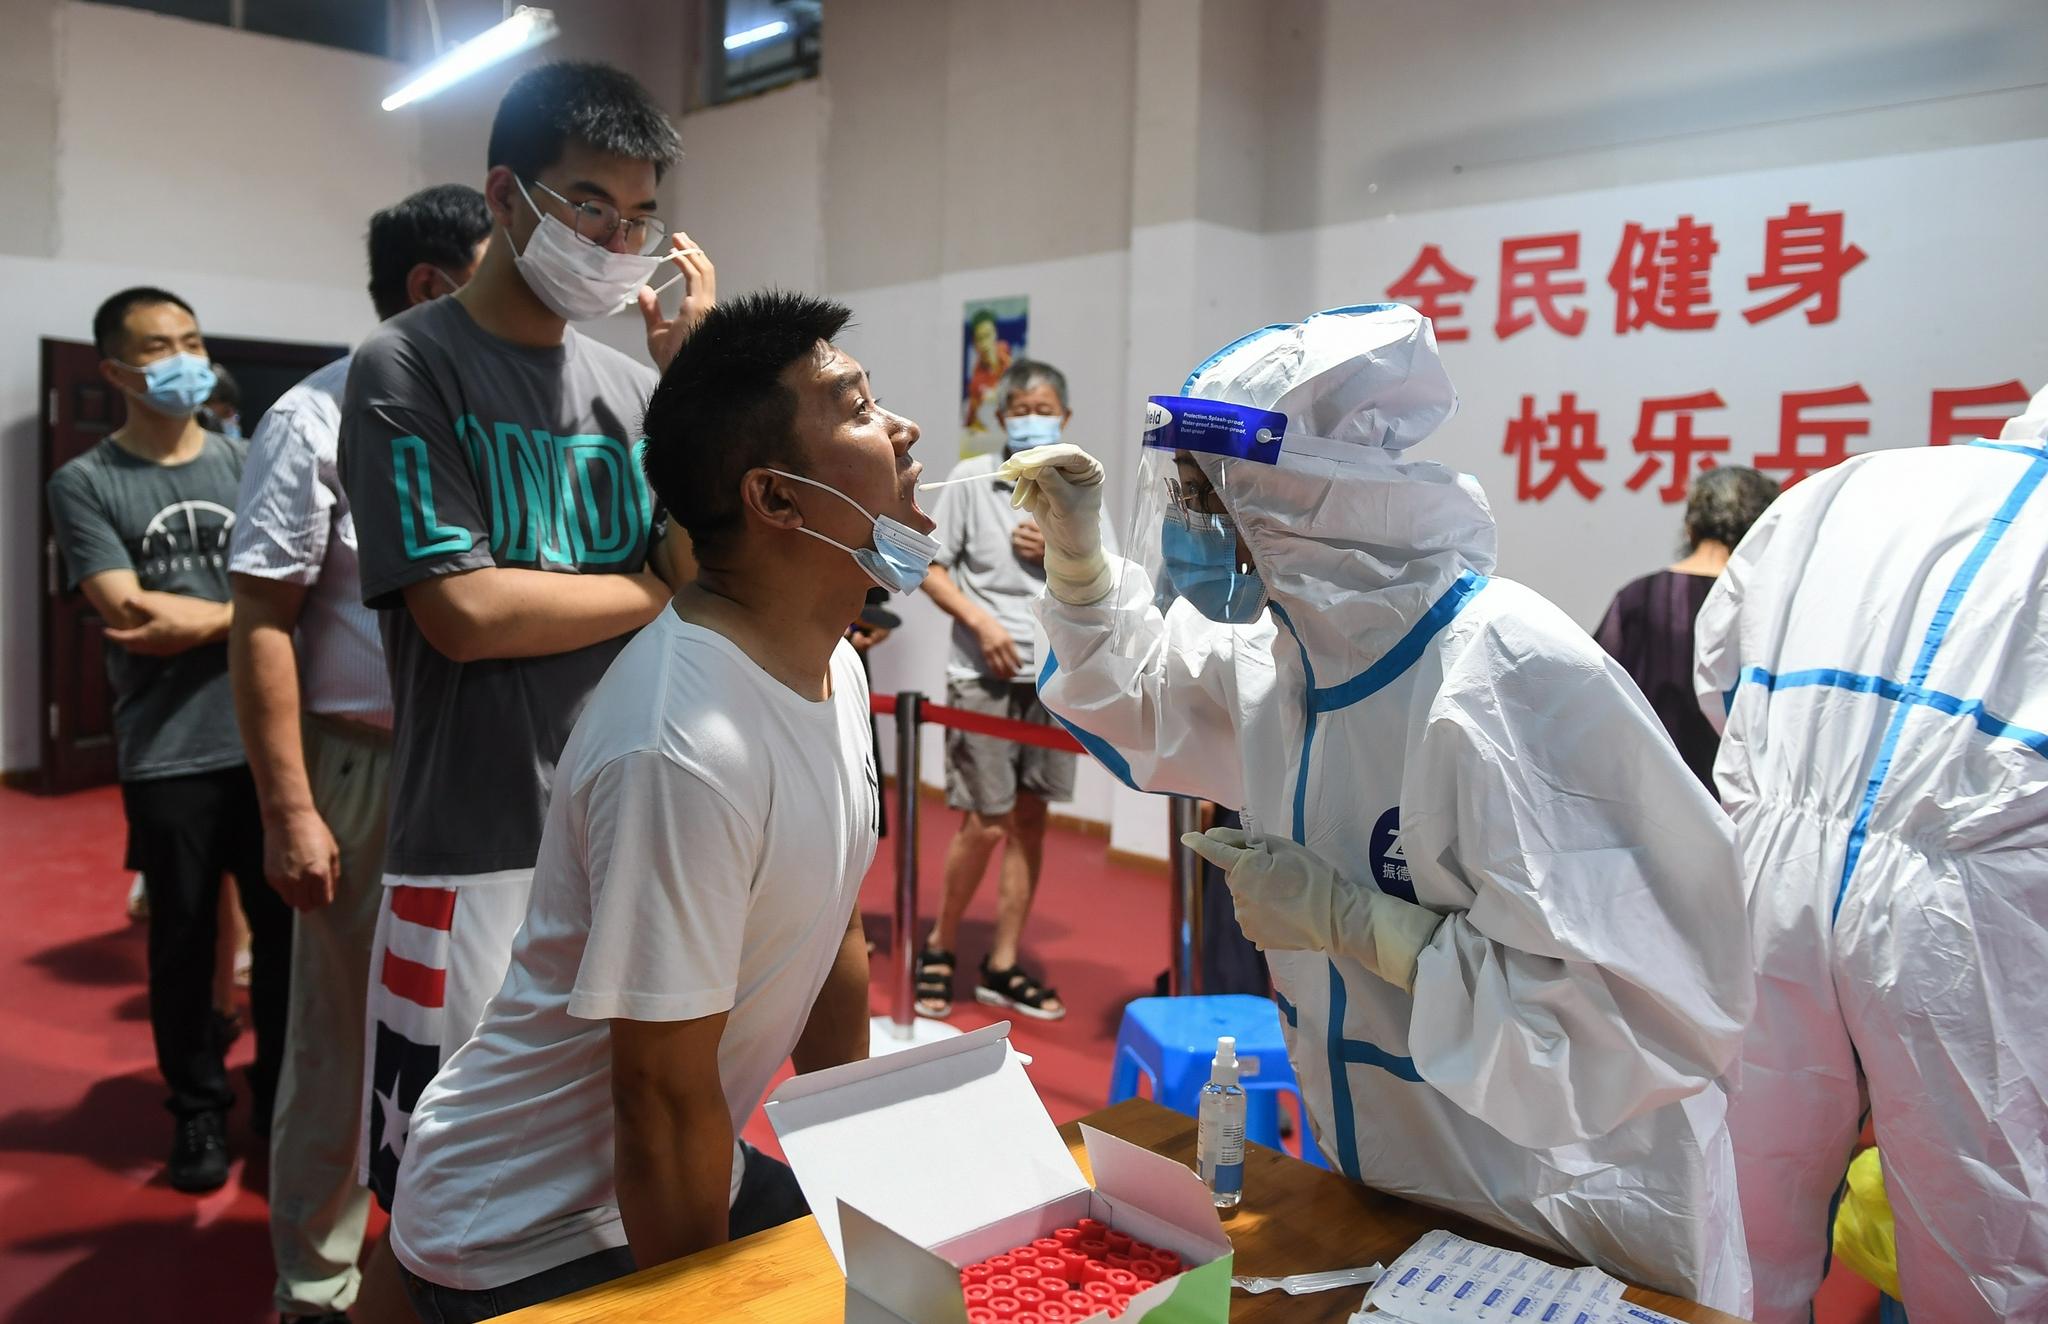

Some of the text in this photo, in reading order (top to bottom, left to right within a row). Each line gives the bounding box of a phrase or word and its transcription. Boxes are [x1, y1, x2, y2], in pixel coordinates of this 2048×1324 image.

[1385, 203, 1868, 342] 全民健身
[390, 412, 651, 564] LOND
